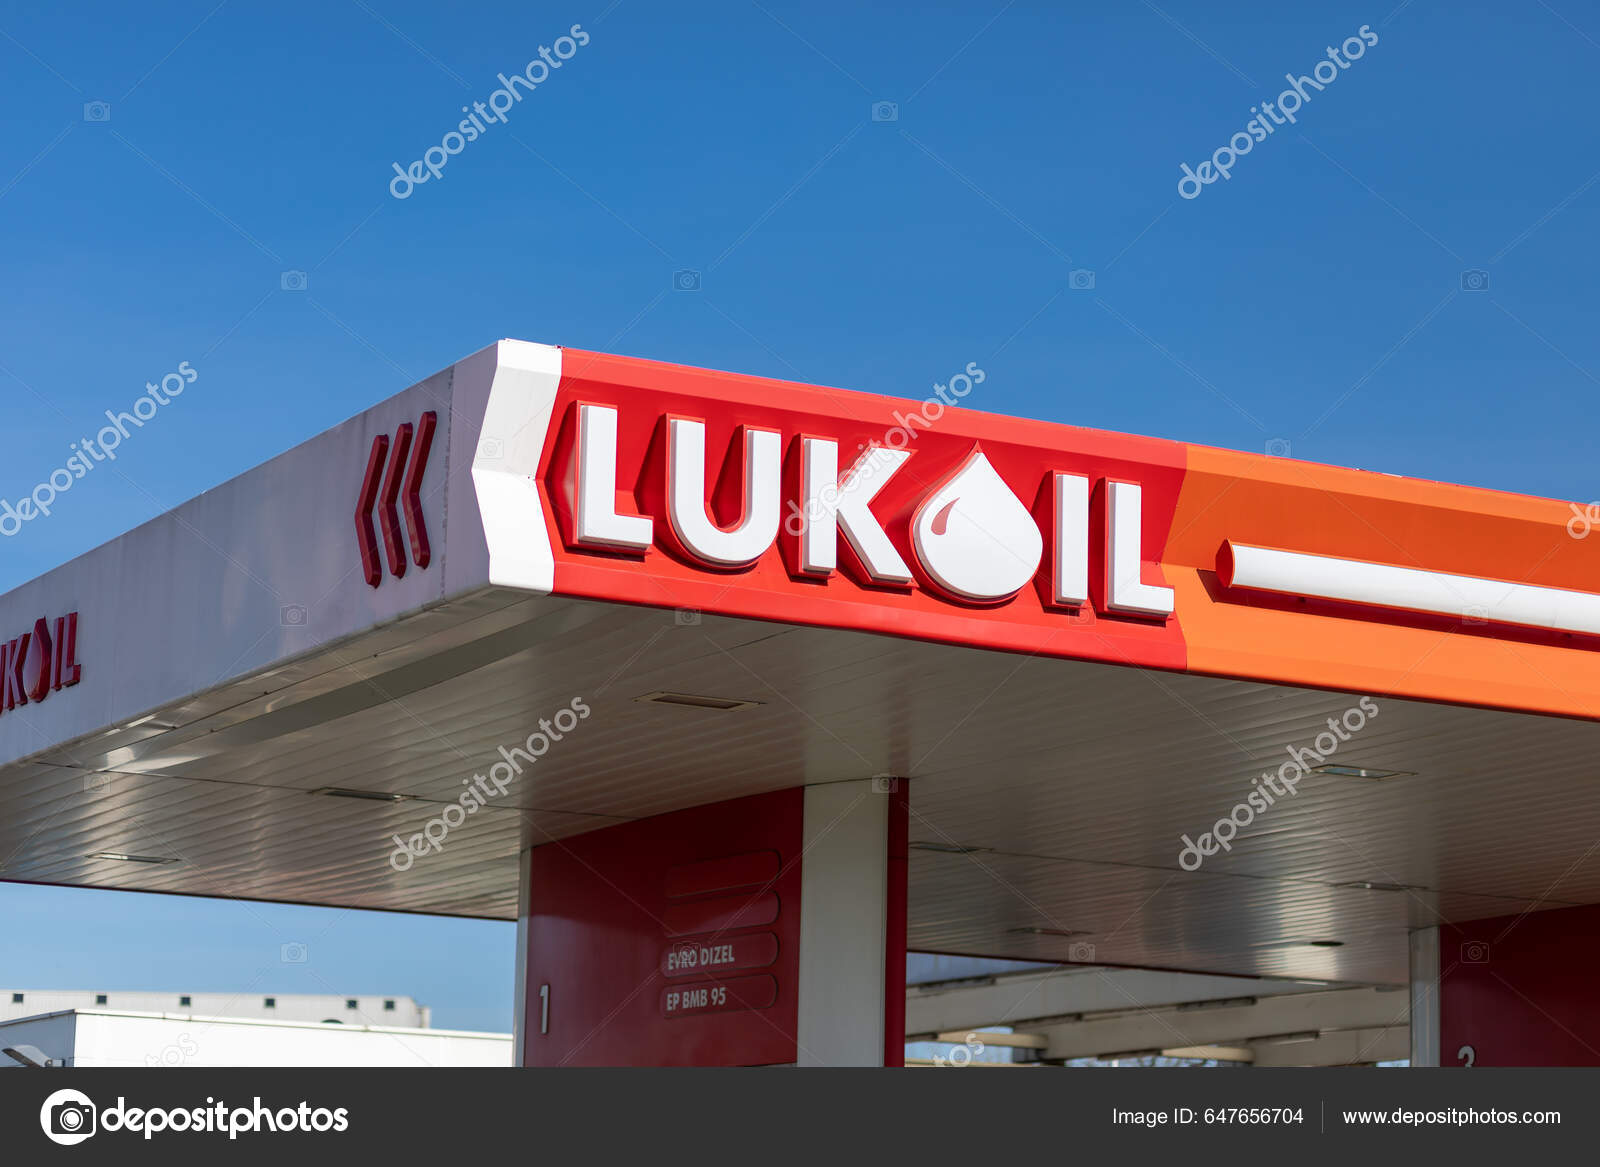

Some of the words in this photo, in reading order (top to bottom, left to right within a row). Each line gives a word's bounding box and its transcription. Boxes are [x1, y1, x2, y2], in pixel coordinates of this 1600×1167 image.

[573, 401, 1175, 620] LUKOIL
[700, 945, 735, 965] DIZEL
[539, 985, 549, 1034] 1
[666, 993, 680, 1011] EP
[682, 989, 708, 1009] BMB
[711, 987, 727, 1006] 95
